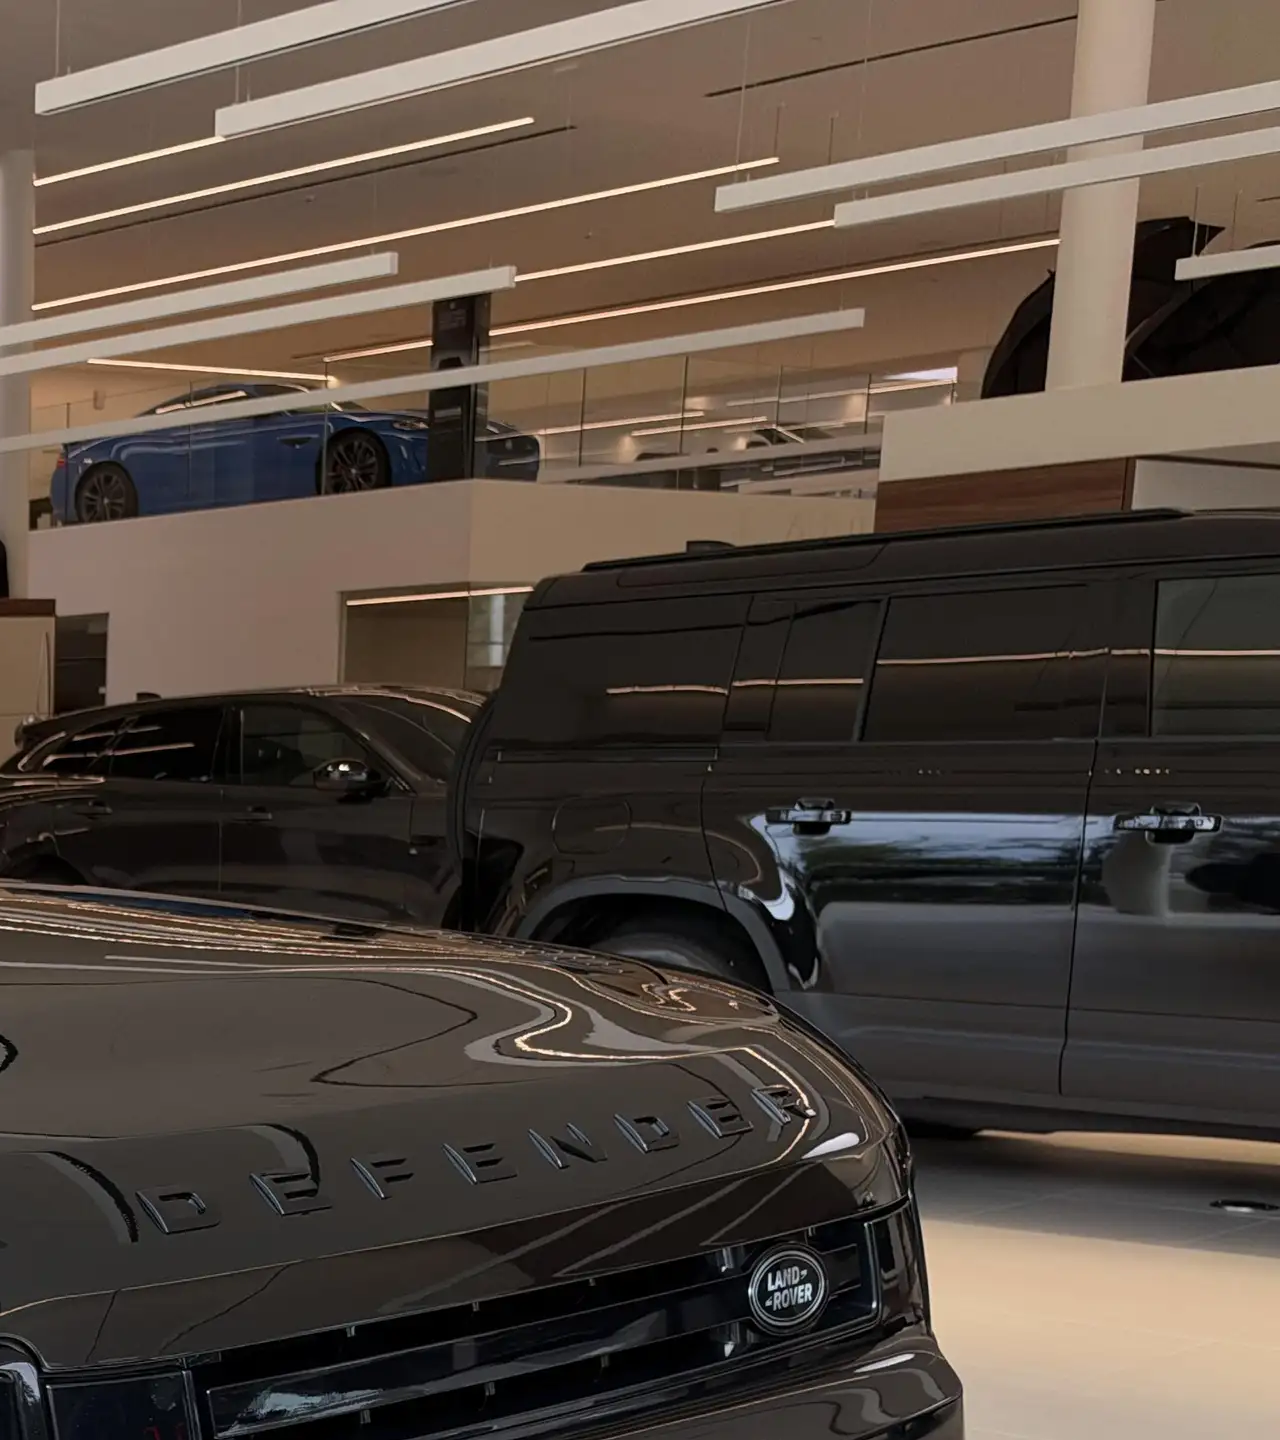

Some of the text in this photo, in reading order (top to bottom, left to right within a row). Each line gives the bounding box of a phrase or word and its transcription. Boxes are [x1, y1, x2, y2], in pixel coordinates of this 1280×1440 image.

[135, 1085, 816, 1235] DEFENDER
[768, 1266, 800, 1291] LAND
[773, 1283, 813, 1311] ROVER
